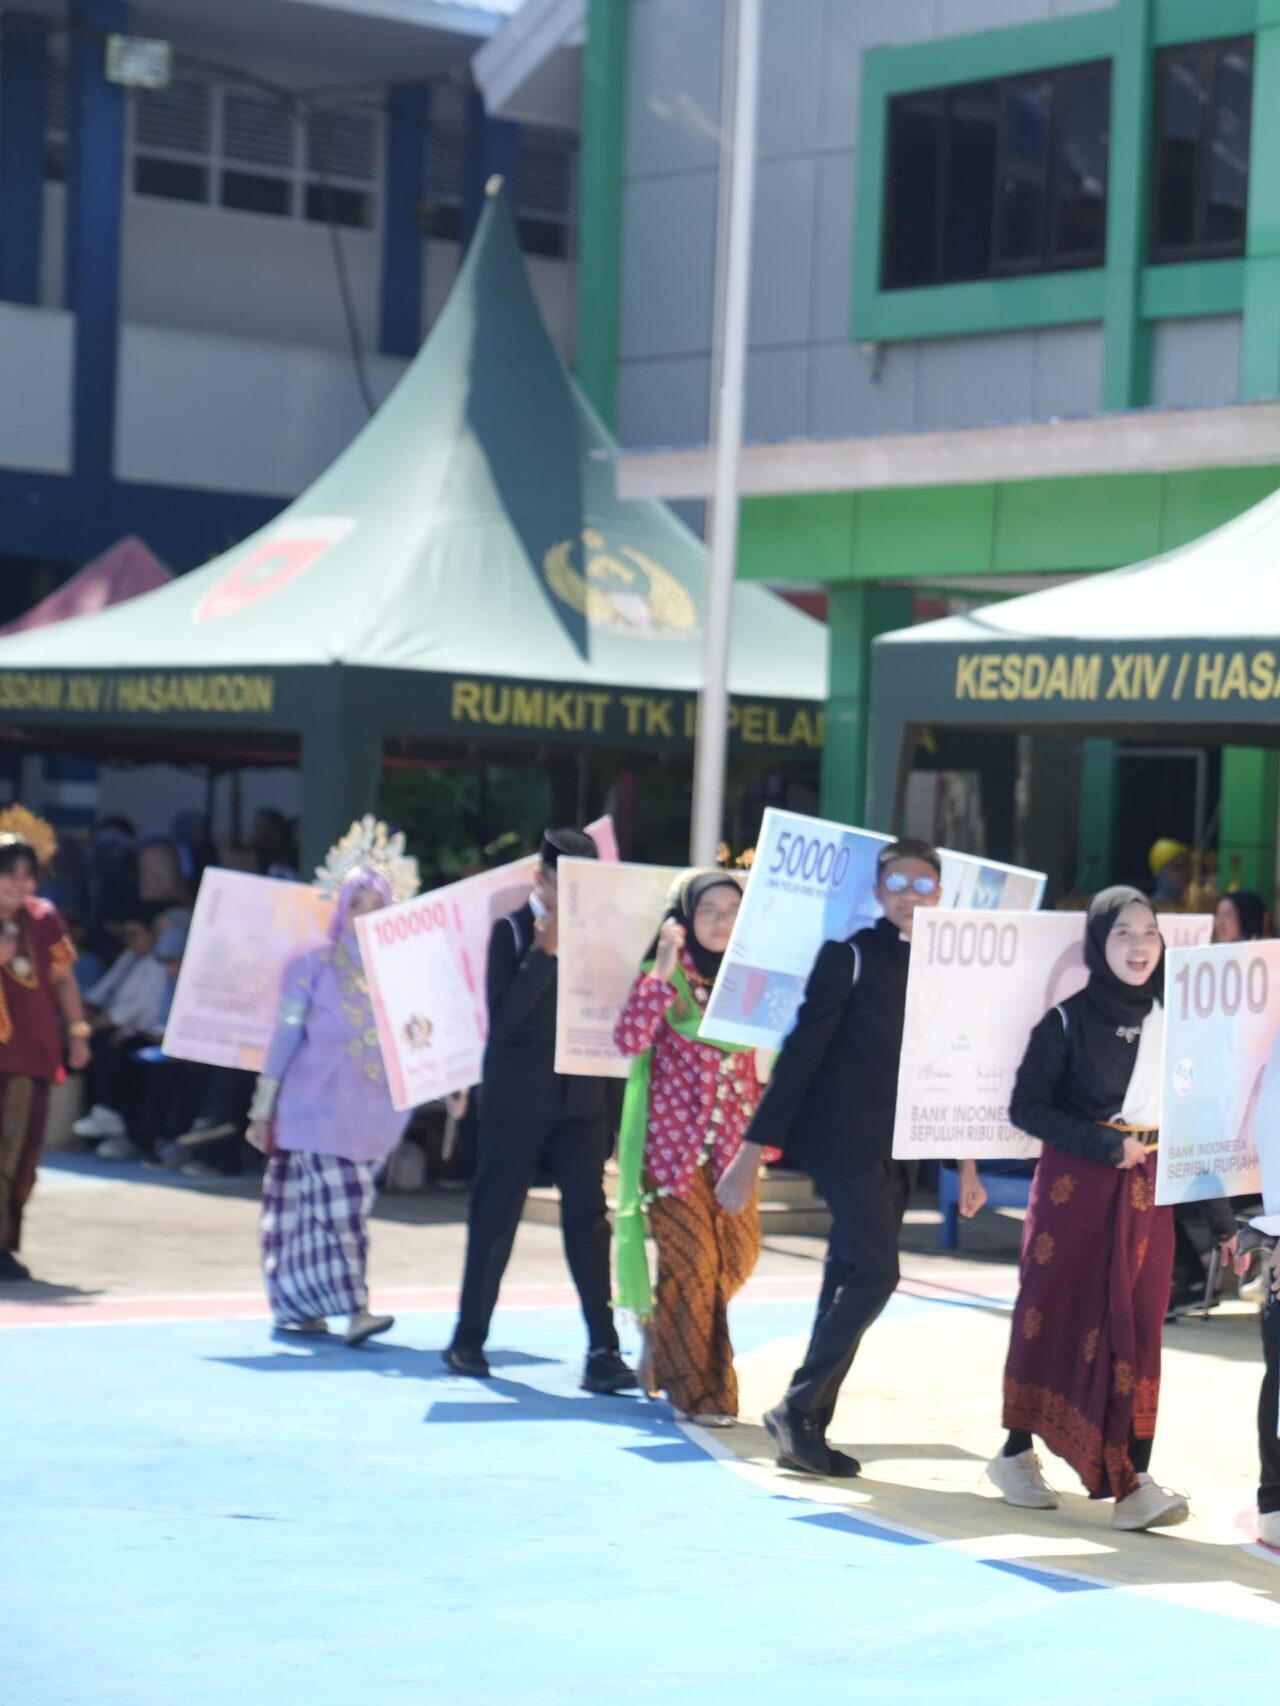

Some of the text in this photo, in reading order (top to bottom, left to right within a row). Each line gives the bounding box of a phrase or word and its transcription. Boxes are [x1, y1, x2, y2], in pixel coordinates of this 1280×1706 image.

[956, 653, 1101, 700] KESDAM
[1106, 653, 1170, 700] XIV
[451, 681, 610, 732] RUMKIT
[621, 695, 673, 738] TK
[768, 830, 851, 888] 50000
[374, 902, 447, 947] 100000
[925, 919, 1019, 968] 10000
[1173, 957, 1270, 1022] 1000
[909, 1105, 949, 1123] BANK
[909, 1123, 965, 1142] SEPULUH
[966, 1123, 995, 1142] RIBU
[1167, 1138, 1247, 1160] BANK INDONESIA
[1167, 1154, 1260, 1180] SERIBU RUPIAH
